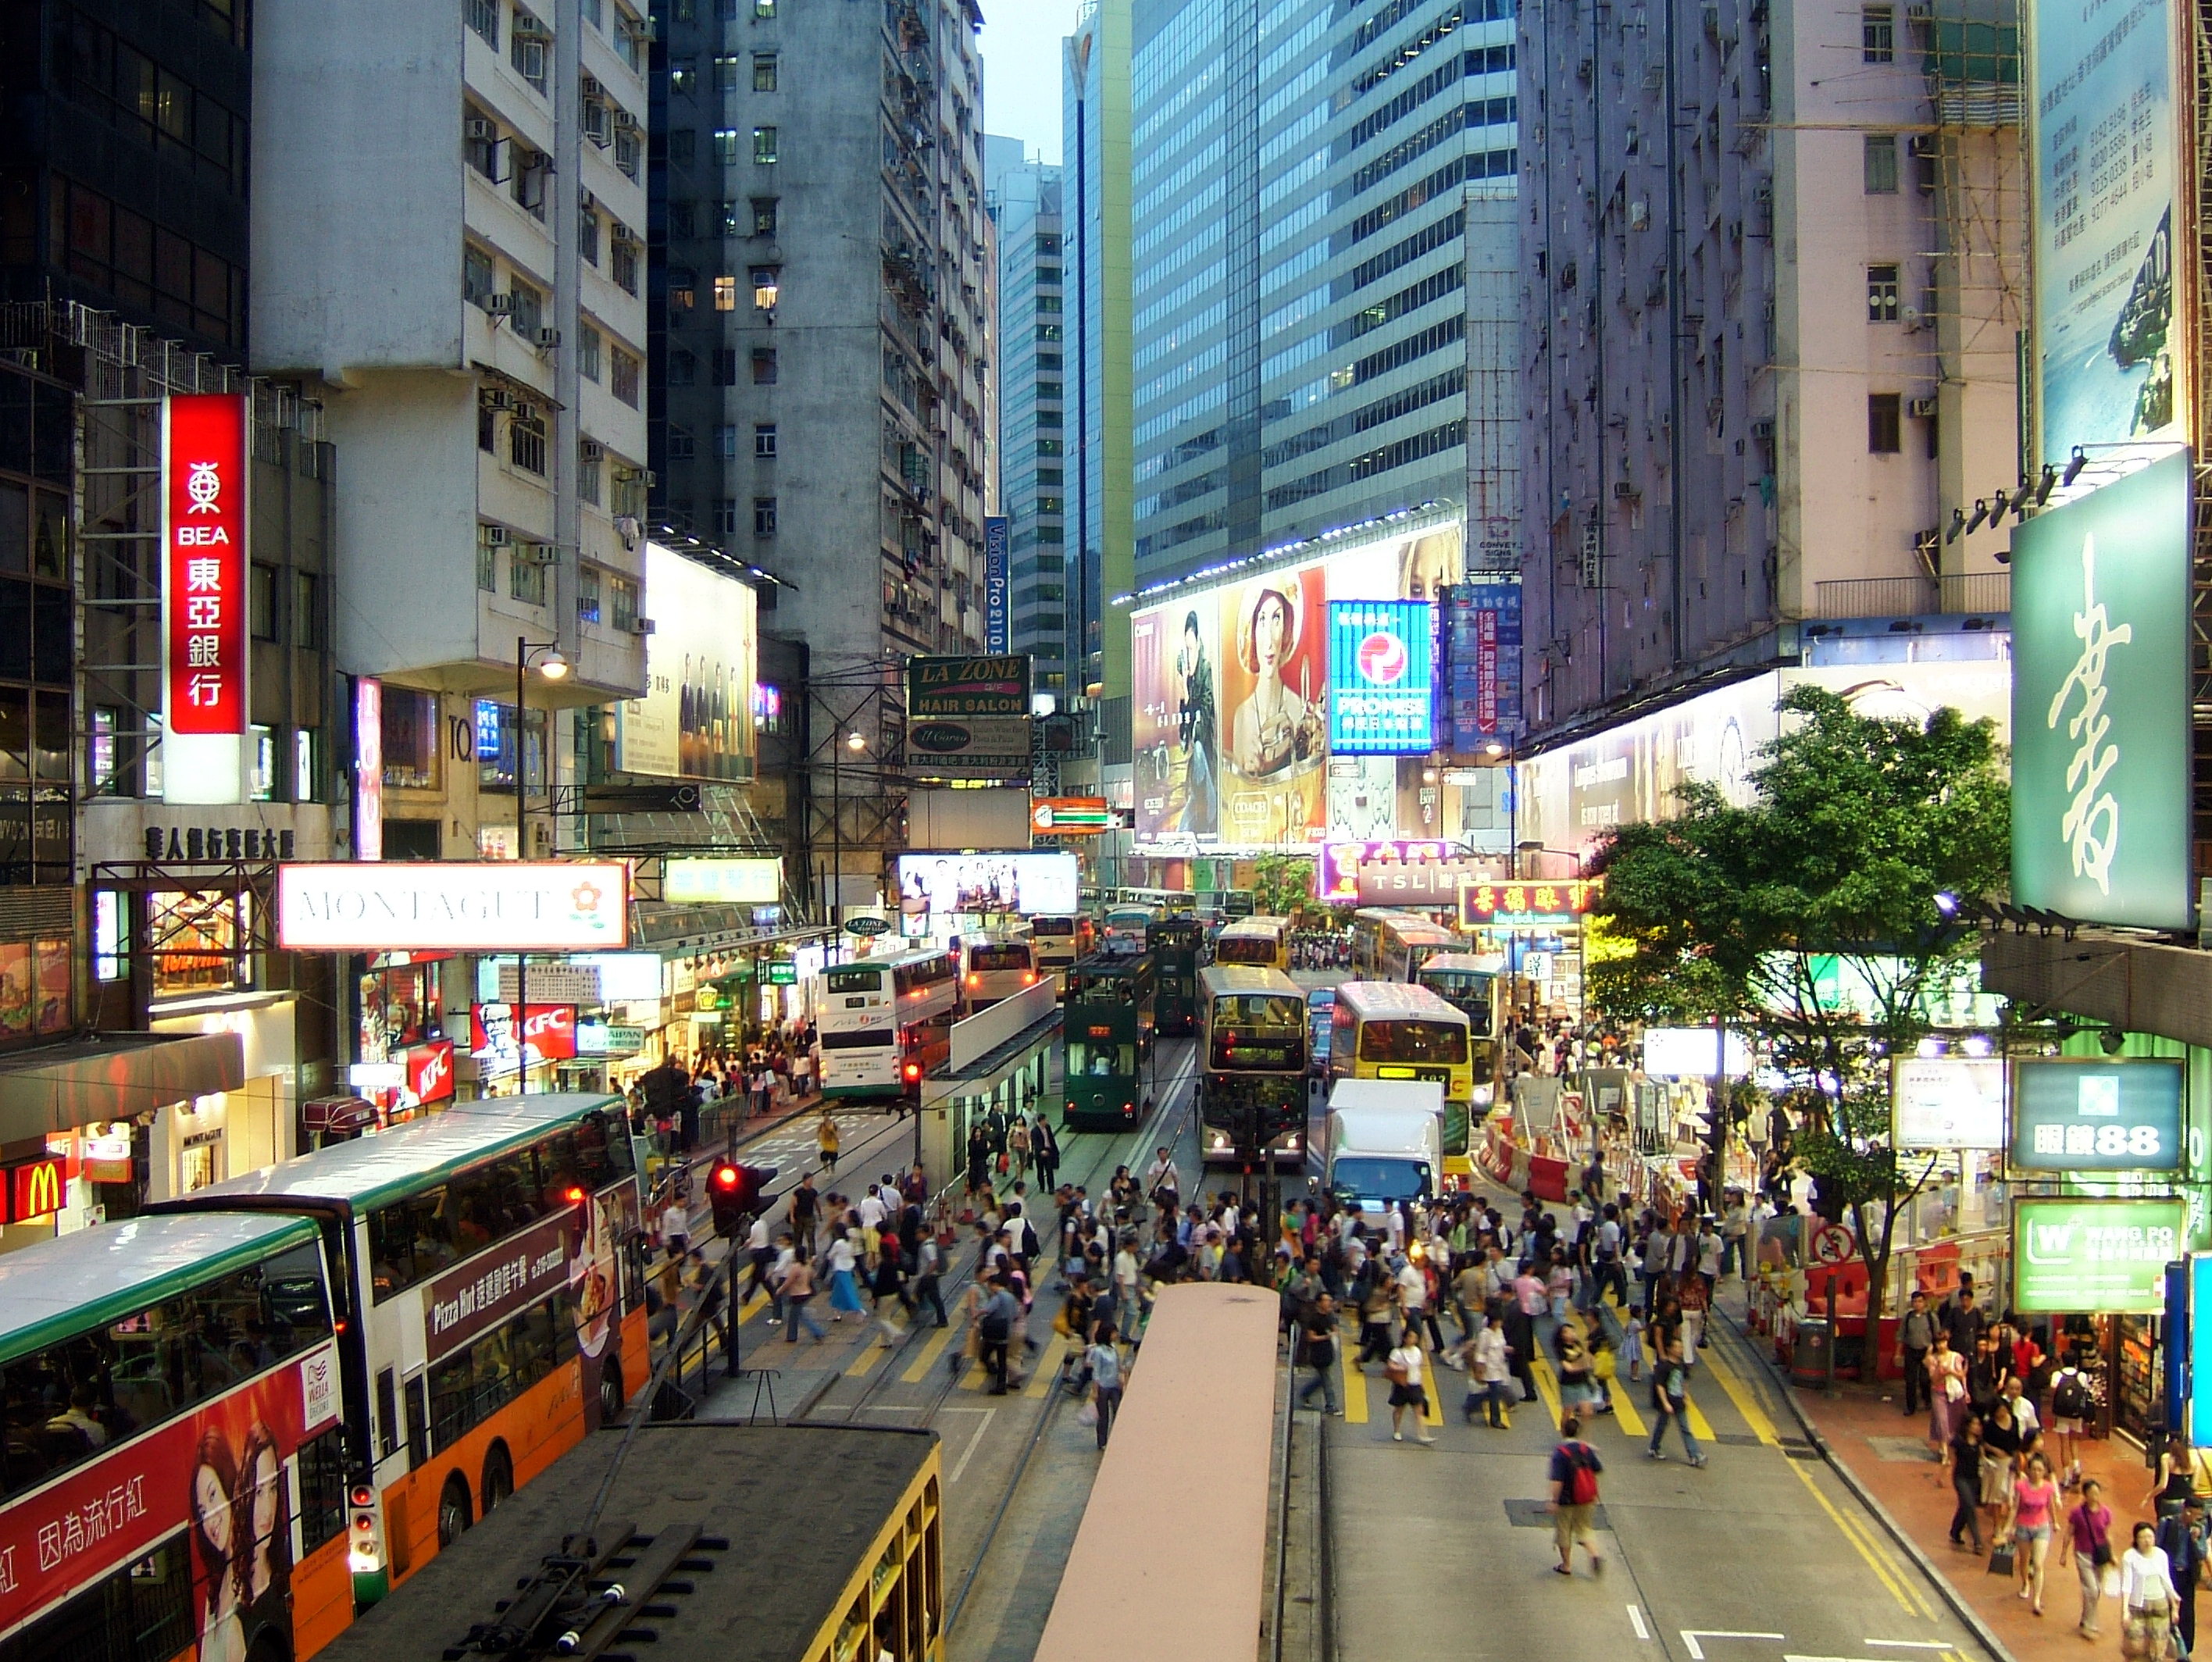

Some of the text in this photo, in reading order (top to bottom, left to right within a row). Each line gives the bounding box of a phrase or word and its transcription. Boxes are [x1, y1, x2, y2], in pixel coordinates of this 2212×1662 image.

[178, 526, 230, 546] BEA
[187, 558, 222, 707] 東亞銀行
[920, 658, 1022, 683] LA ZONE
[919, 699, 1022, 712] HAIR SALON
[1337, 697, 1425, 715] PROMISE
[1372, 874, 1425, 890] TSL
[300, 890, 550, 921] MONTAGUT
[520, 1008, 568, 1038] KFC
[419, 1047, 449, 1097] KFC
[184, 1128, 223, 1147] MONTAGUT
[433, 1300, 458, 1336] Pizza
[459, 1285, 476, 1319] Hut
[37, 1474, 148, 1572] 因為流行紅
